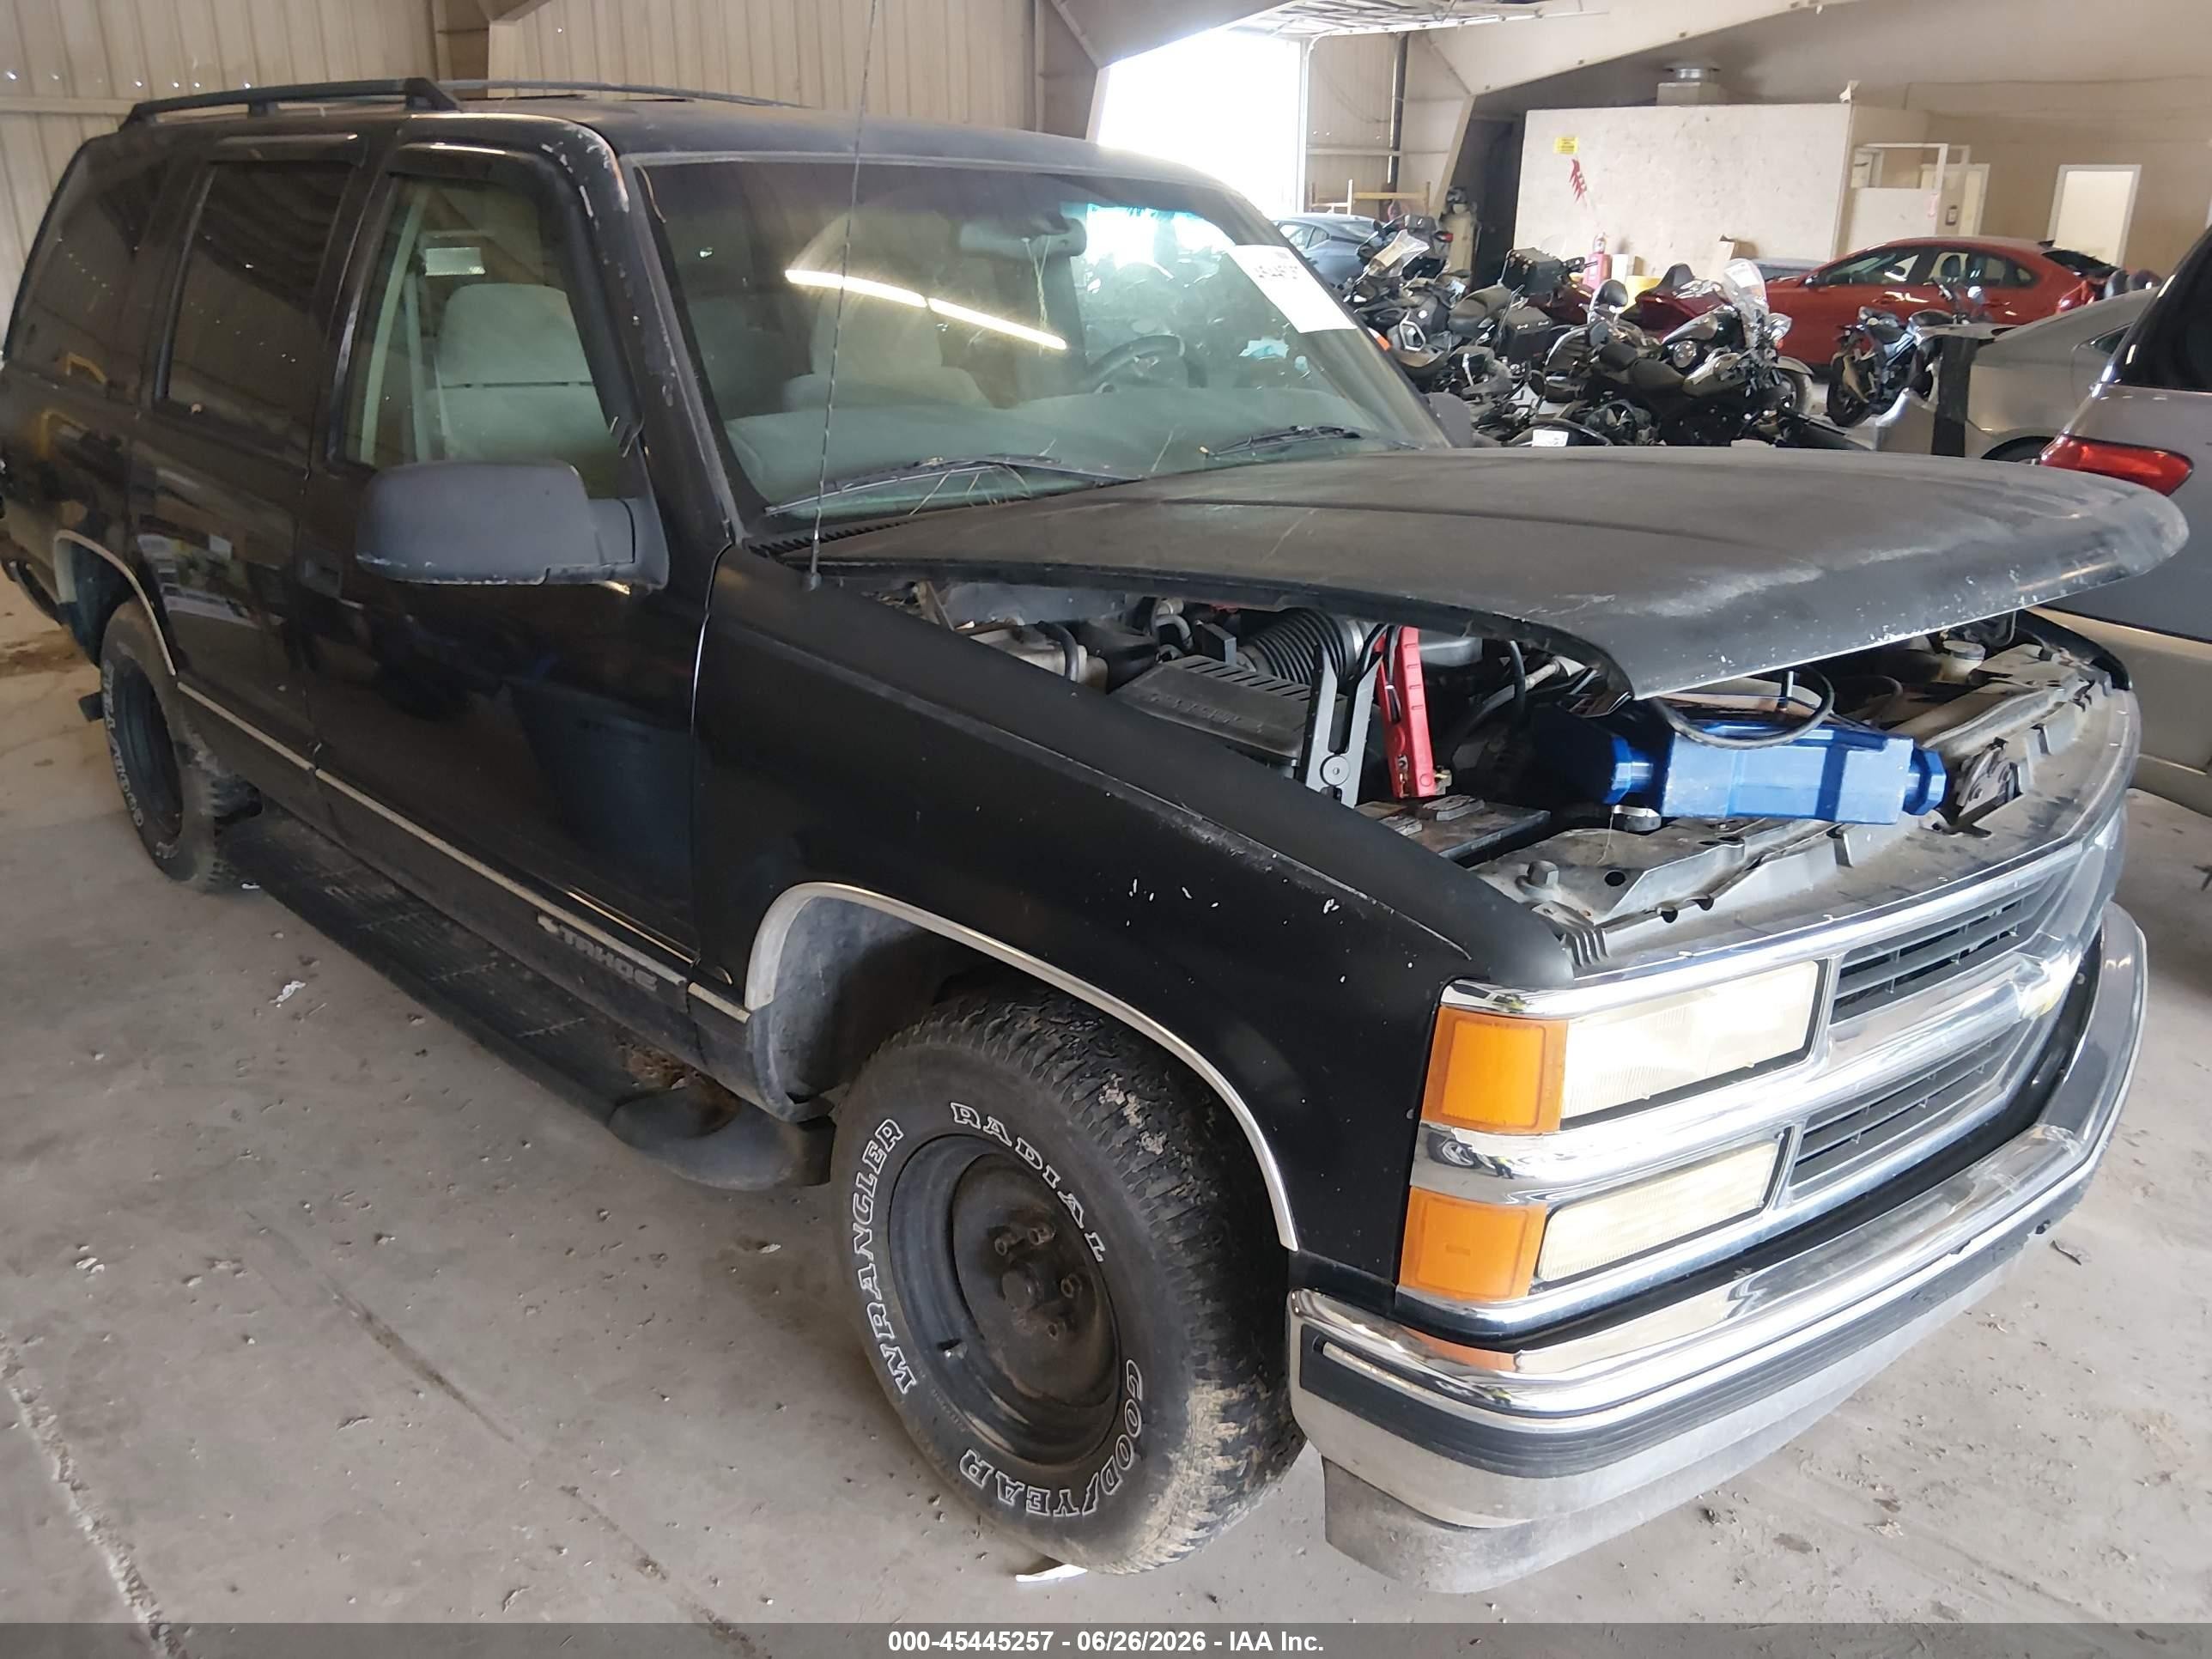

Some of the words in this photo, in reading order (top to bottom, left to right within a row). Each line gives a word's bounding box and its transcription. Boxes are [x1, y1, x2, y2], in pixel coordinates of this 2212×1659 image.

[558, 926, 658, 992] TAHOE
[852, 1118, 918, 1395] WRANGLER
[949, 1101, 1107, 1263] RADIAL
